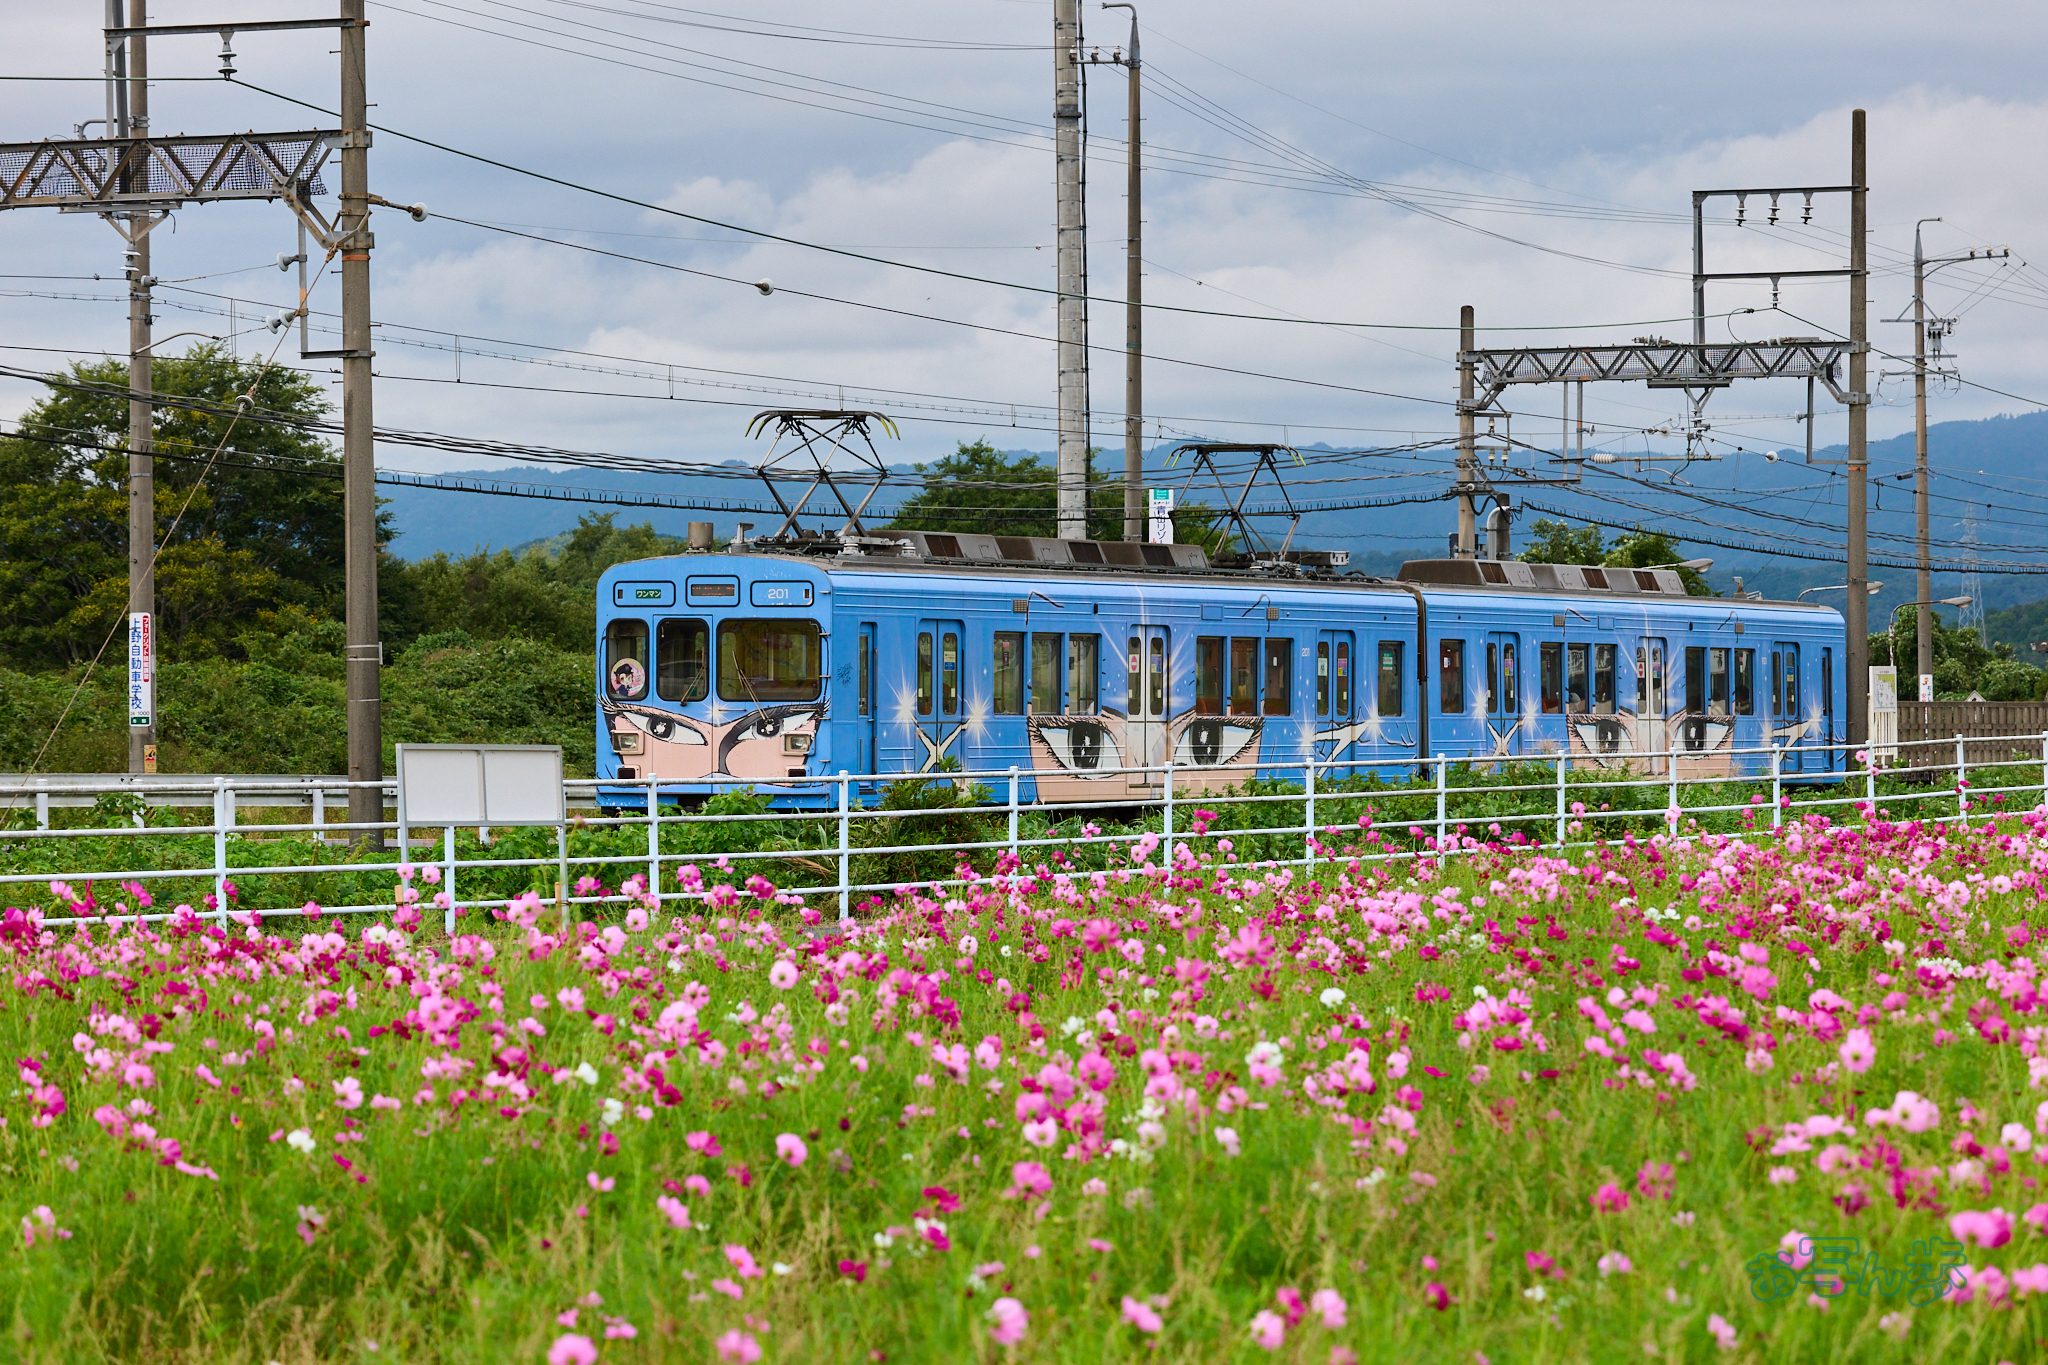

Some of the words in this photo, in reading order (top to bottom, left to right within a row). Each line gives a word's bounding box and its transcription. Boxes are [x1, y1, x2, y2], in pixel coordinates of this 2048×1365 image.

[636, 590, 661, 598] ワンマン
[768, 588, 789, 599] 201
[1301, 647, 1310, 656] 201
[131, 618, 142, 710] 上野自動車学校
